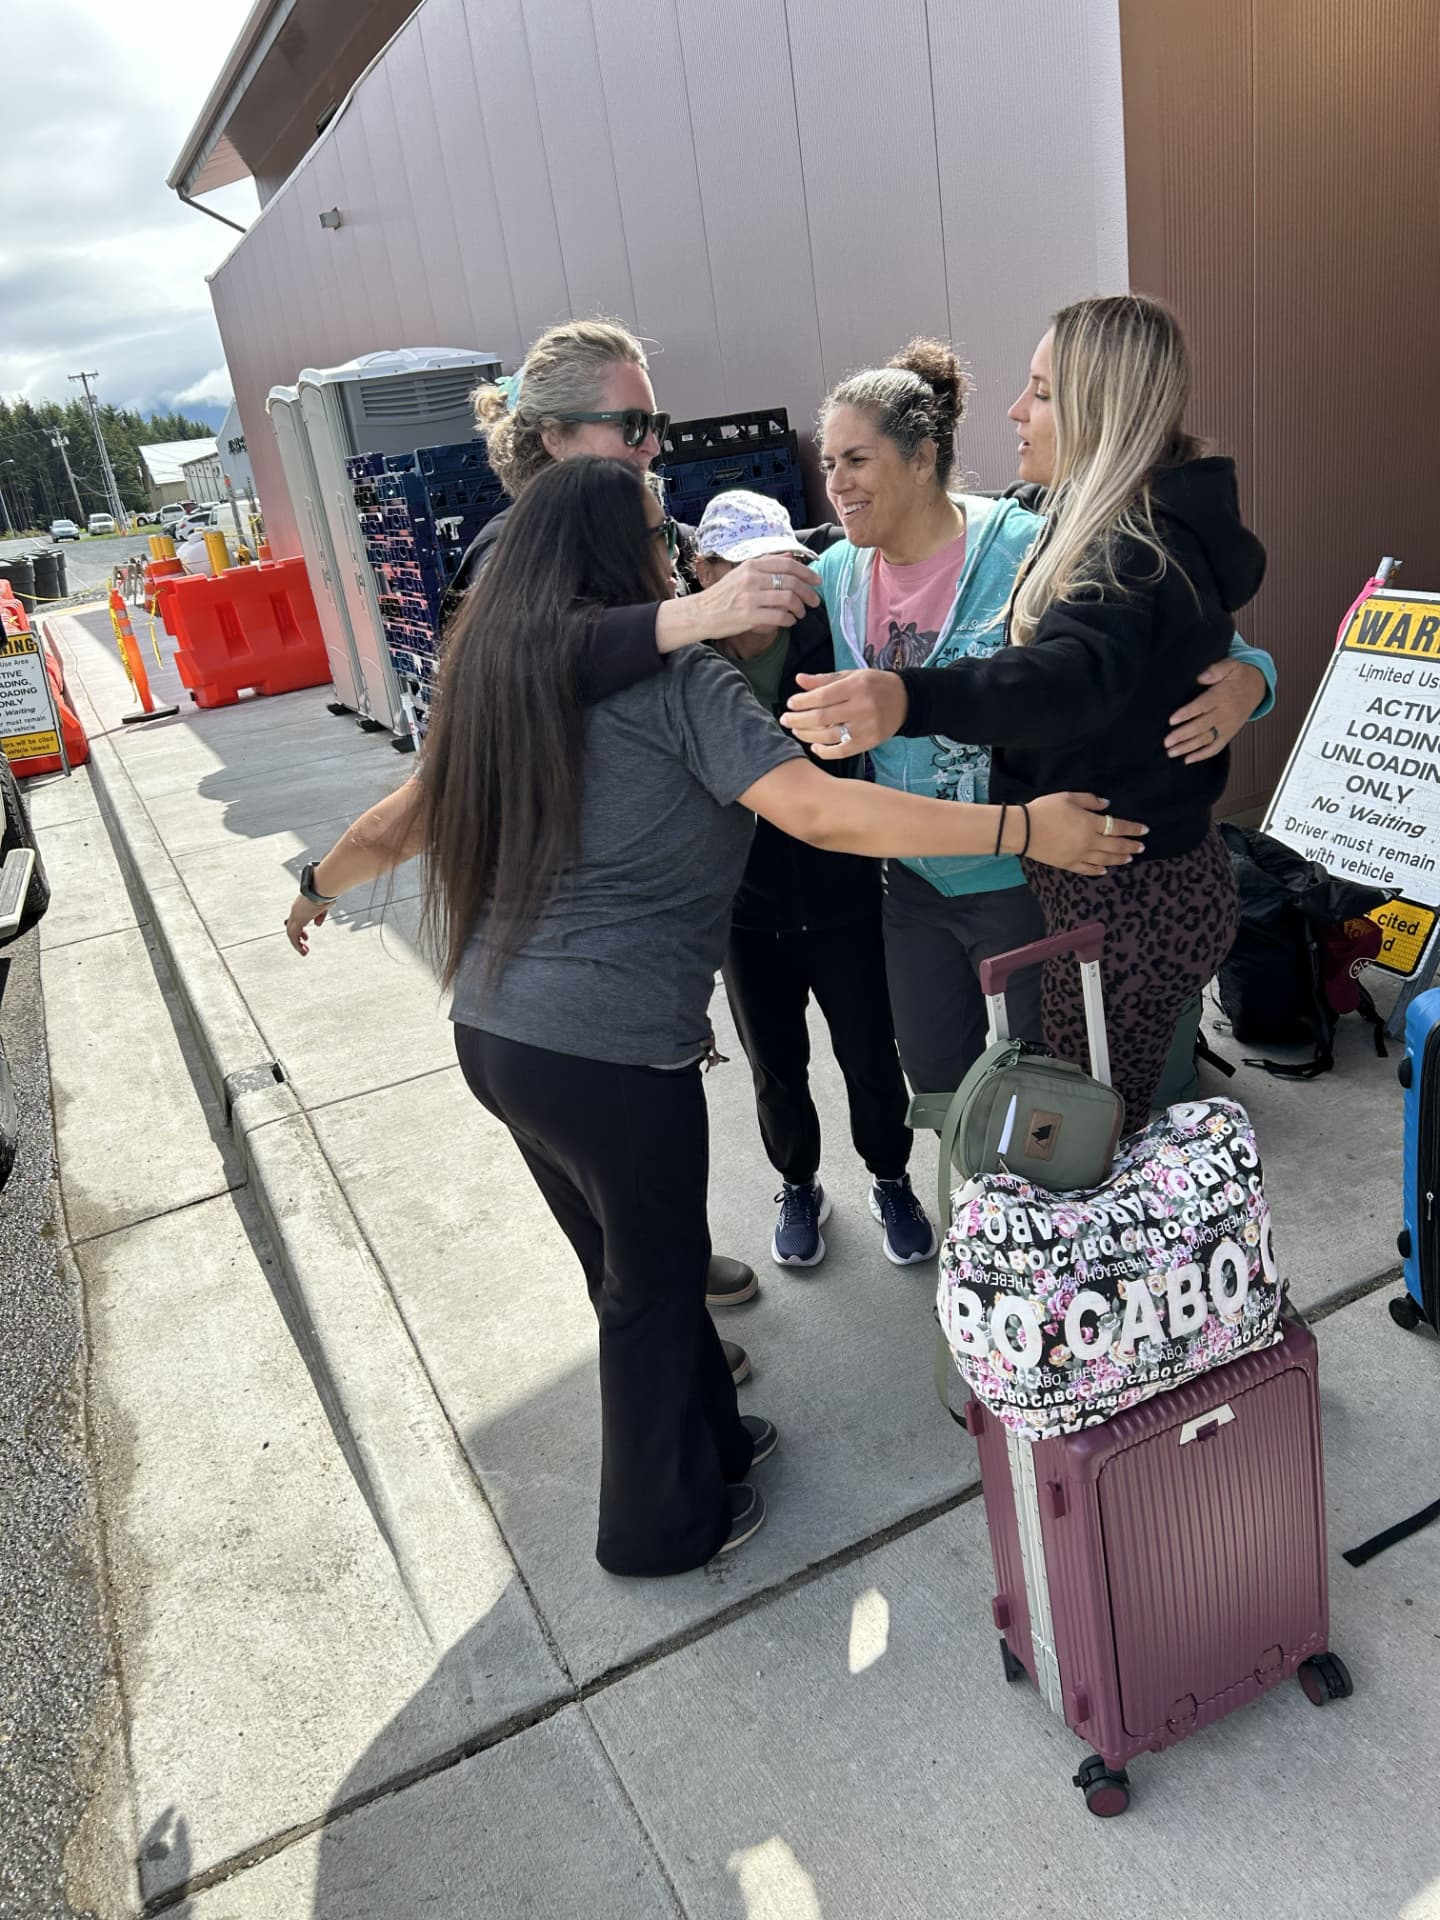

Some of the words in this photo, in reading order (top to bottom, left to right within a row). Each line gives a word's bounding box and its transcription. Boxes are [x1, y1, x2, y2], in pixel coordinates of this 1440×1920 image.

[1356, 609, 1440, 654] WAR
[0, 669, 22, 679] TIVE
[1358, 663, 1415, 686] Limited
[1418, 671, 1440, 689] Us
[1366, 696, 1440, 726] ACTIV
[1346, 719, 1440, 755] LOADIN
[1321, 741, 1440, 784] UNLOADIN
[1345, 774, 1414, 804] ONLY
[1311, 796, 1340, 814] No
[1349, 804, 1427, 839] Waiting
[1284, 816, 1329, 841] Driver
[1333, 832, 1374, 854] must
[1378, 846, 1436, 872] remain
[1305, 847, 1335, 866] with
[1341, 857, 1395, 883] vehicle
[1377, 912, 1420, 936] cited
[1166, 1136, 1259, 1202] CABO
[1052, 1234, 1116, 1268] CABO
[1120, 1220, 1182, 1254] CABO
[1182, 1184, 1245, 1227] CABO
[947, 1286, 1044, 1370] BO
[1063, 1240, 1250, 1362] CABO
[1030, 1387, 1077, 1408] CABO
[1126, 1366, 1171, 1385] CABO
